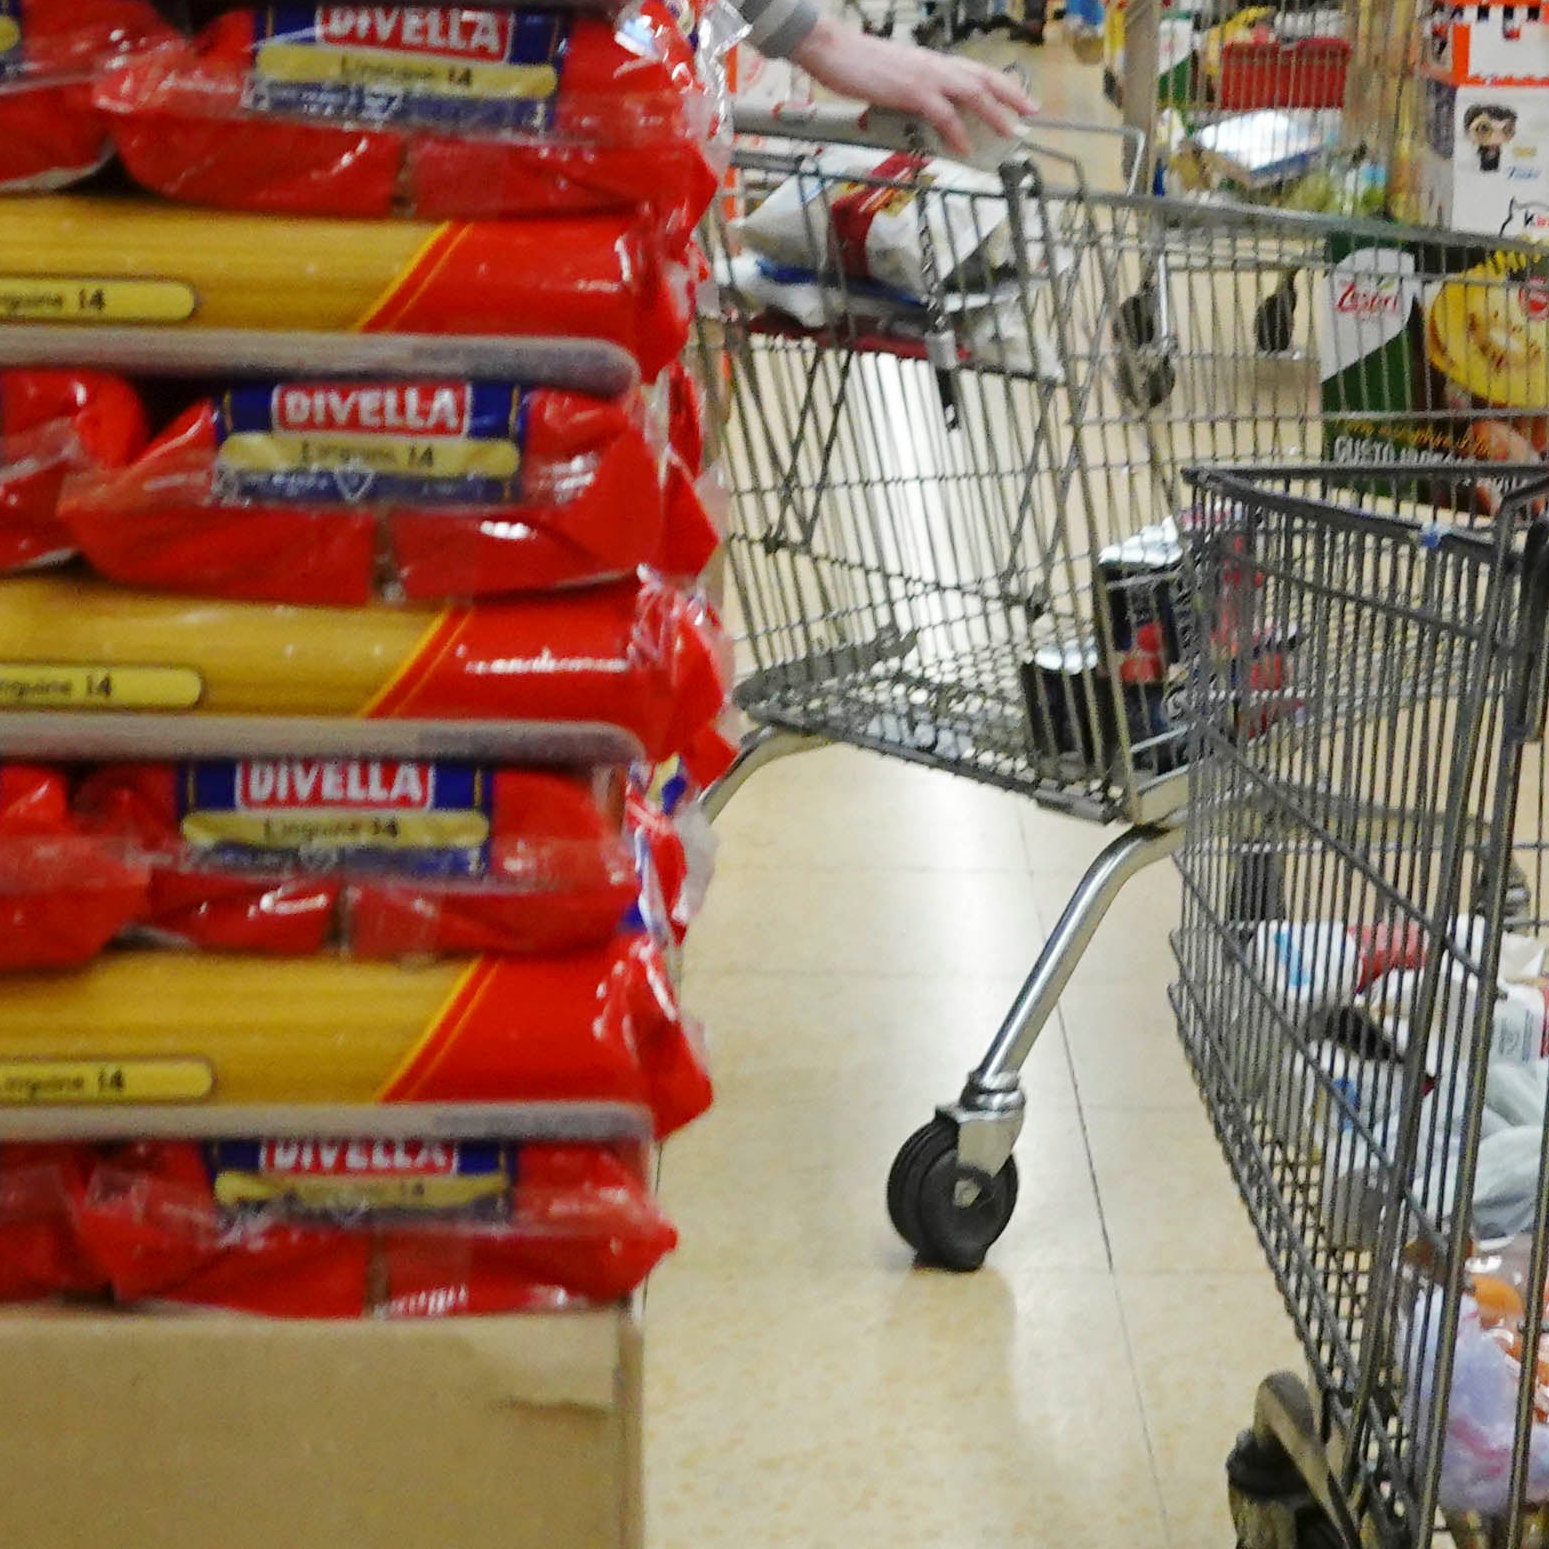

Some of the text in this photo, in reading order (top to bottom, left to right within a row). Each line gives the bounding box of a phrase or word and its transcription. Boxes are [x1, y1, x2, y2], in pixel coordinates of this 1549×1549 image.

[328, 8, 500, 53] DIVELLA
[78, 288, 105, 311] 14
[283, 389, 458, 430] DIVELLA
[85, 674, 112, 697] 14
[250, 758, 423, 801] DIVELLA
[97, 1069, 125, 1092] 14
